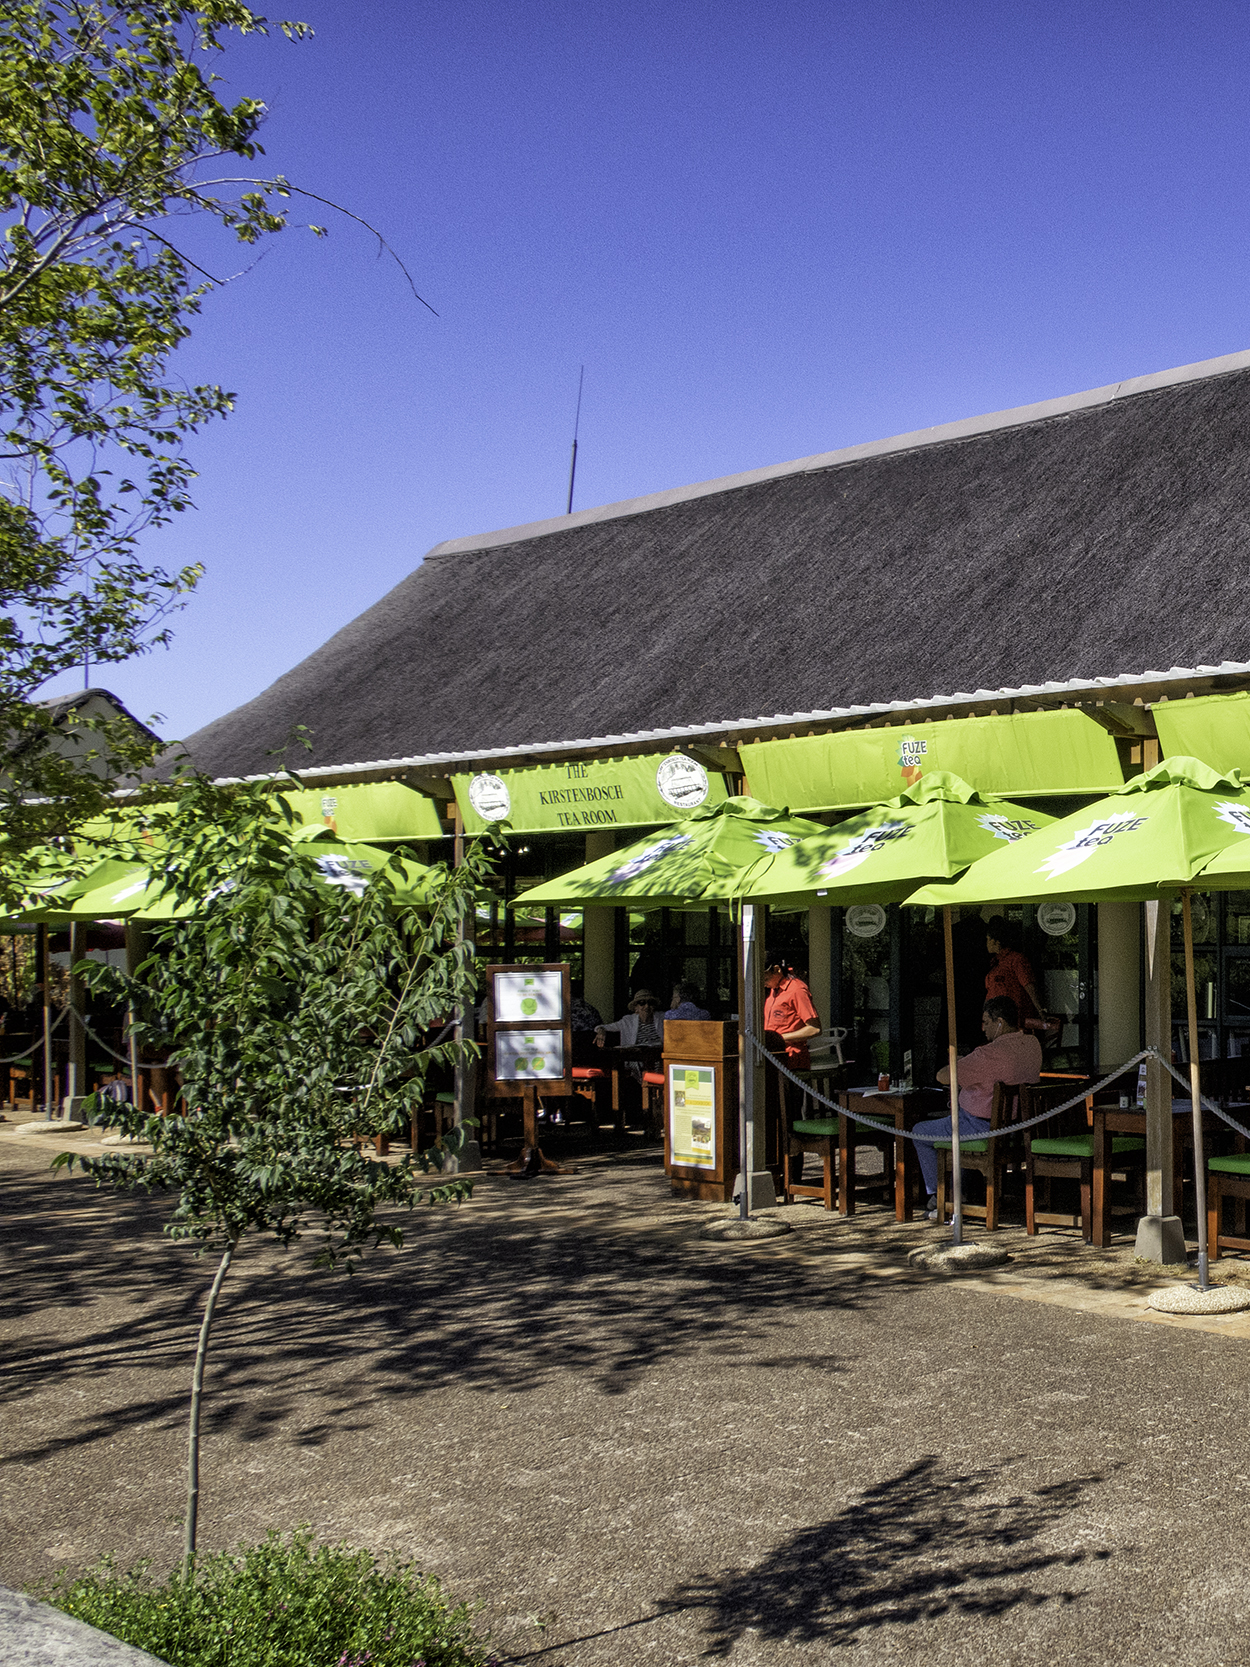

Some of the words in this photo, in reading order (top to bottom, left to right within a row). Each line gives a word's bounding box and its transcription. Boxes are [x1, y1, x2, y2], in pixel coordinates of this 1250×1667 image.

[902, 740, 927, 755] FUZE
[903, 755, 921, 766] tea
[565, 764, 588, 779] THE
[539, 785, 624, 805] KIRSTENBOSCH
[557, 812, 581, 826] TEA
[581, 809, 618, 825] ROOM
[988, 820, 1041, 831] FUZE
[1087, 817, 1149, 837] FUZE
[860, 824, 917, 844] FUZE
[767, 836, 804, 847] FU
[849, 841, 886, 854] tea
[1075, 835, 1113, 848] tea
[324, 860, 373, 874] FUZE
